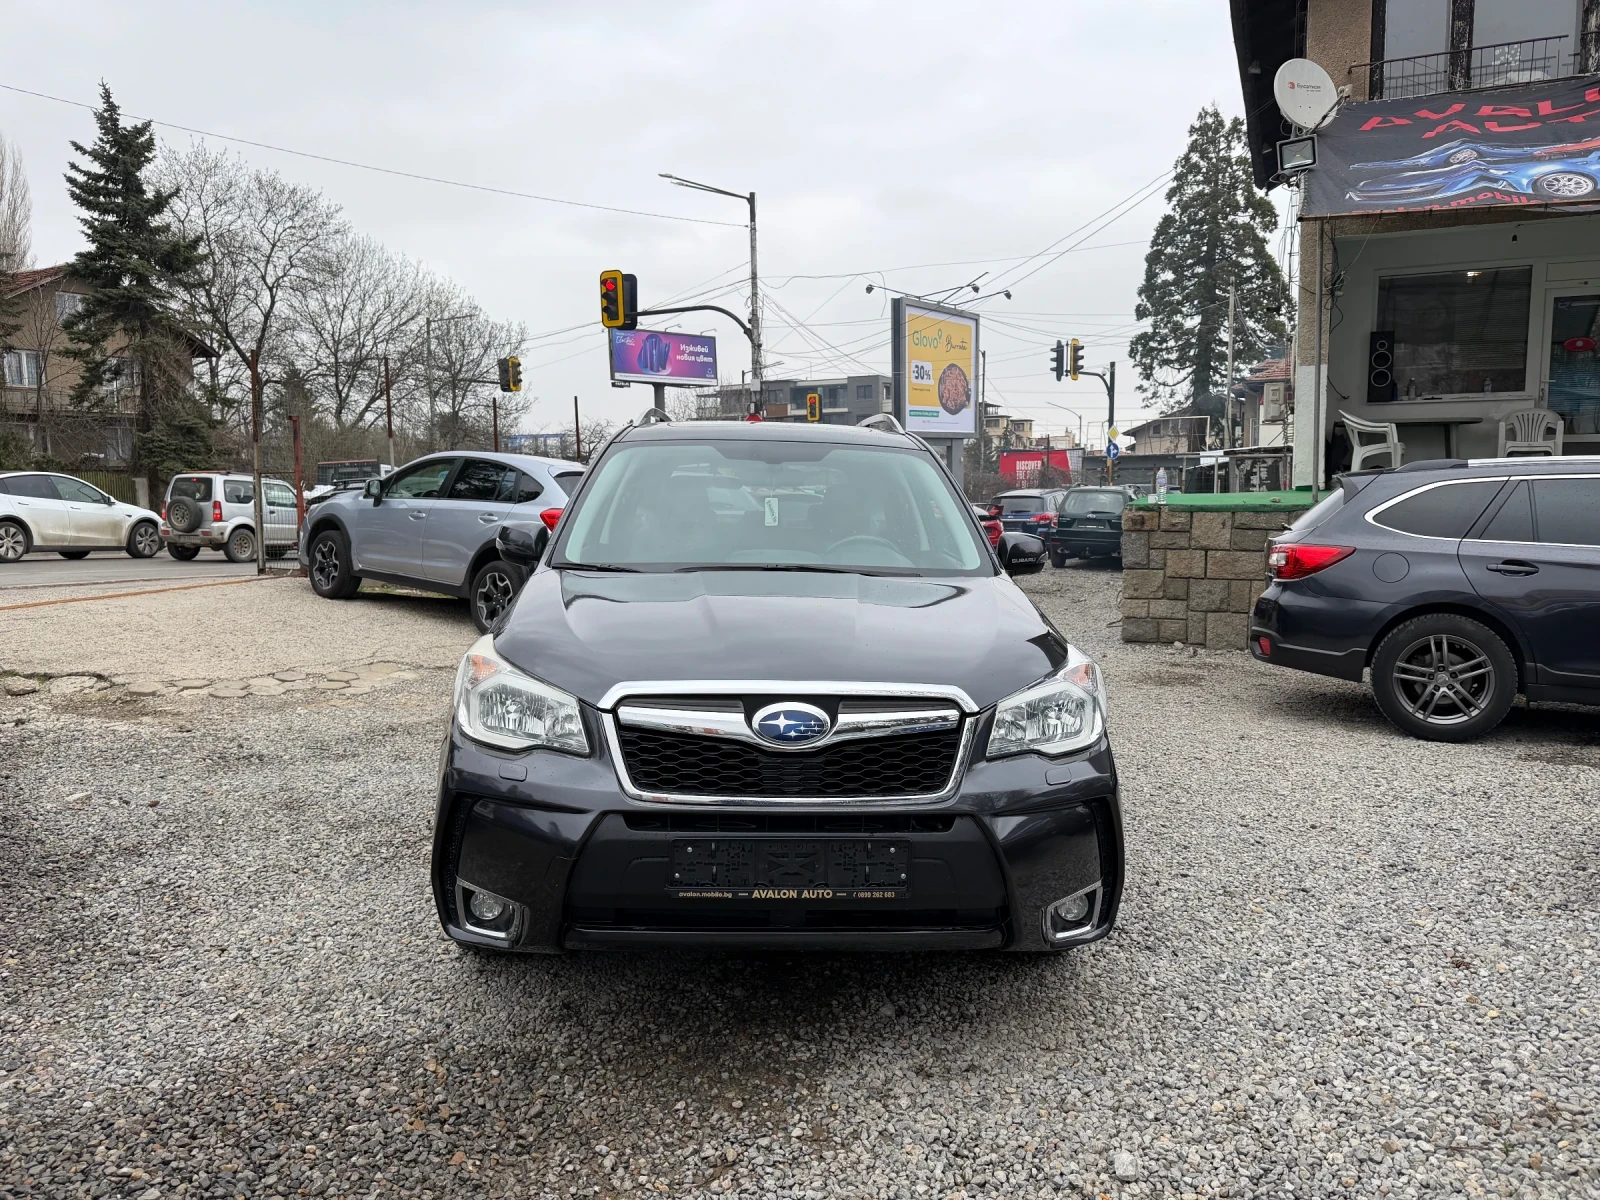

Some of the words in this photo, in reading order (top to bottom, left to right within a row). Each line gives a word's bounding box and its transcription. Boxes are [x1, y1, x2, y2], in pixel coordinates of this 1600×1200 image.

[912, 330, 939, 349] Glovo
[680, 343, 709, 353] Изживей
[676, 353, 695, 361] новия
[696, 354, 713, 362] цвят
[912, 364, 931, 380] -30%
[1016, 460, 1042, 470] DISCOVER
[752, 889, 798, 899] AVALON
[801, 889, 833, 899] AUTO
